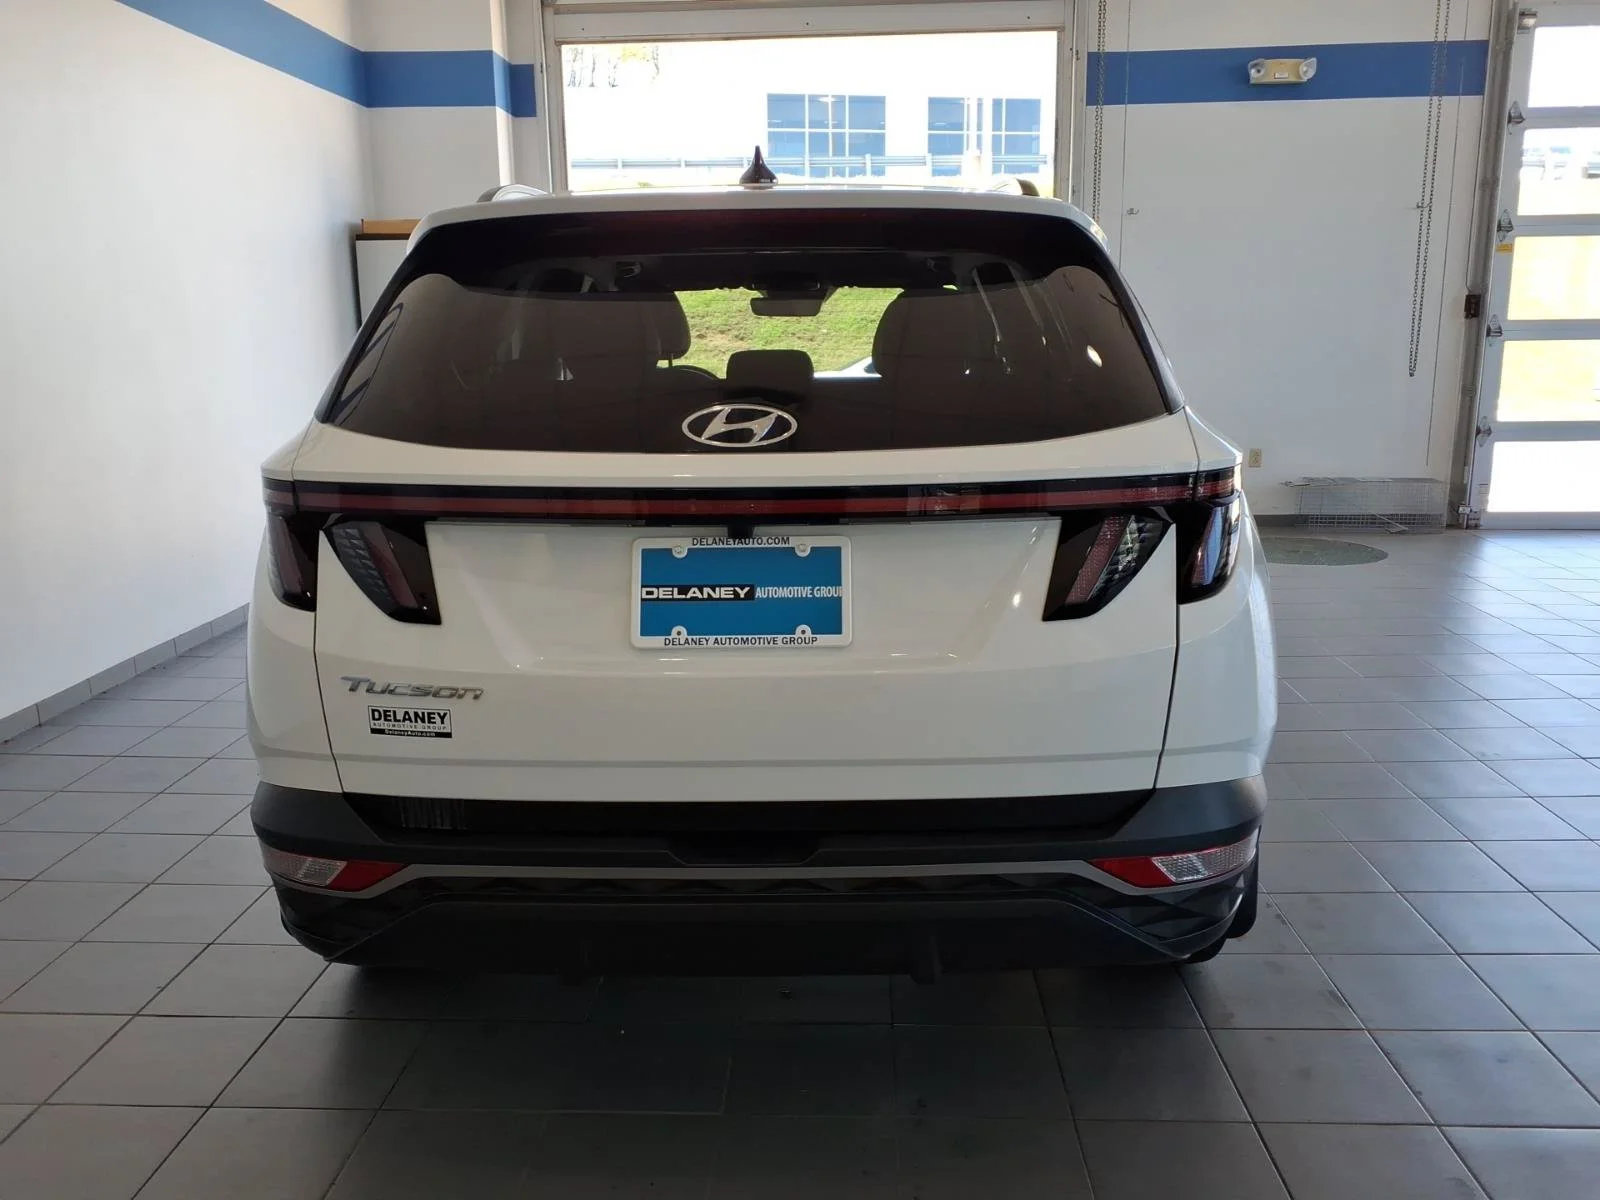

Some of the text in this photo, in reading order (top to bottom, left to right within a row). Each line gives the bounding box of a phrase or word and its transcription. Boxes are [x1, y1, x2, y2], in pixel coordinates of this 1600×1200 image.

[691, 537, 790, 546] DELANEYAUTO.COM
[641, 587, 750, 598] DELANEY
[755, 586, 812, 598] AUTOMOTIVE
[664, 636, 818, 646] DELANEY AUTOMOTIVE GROUP
[371, 708, 448, 725] DELANEY
